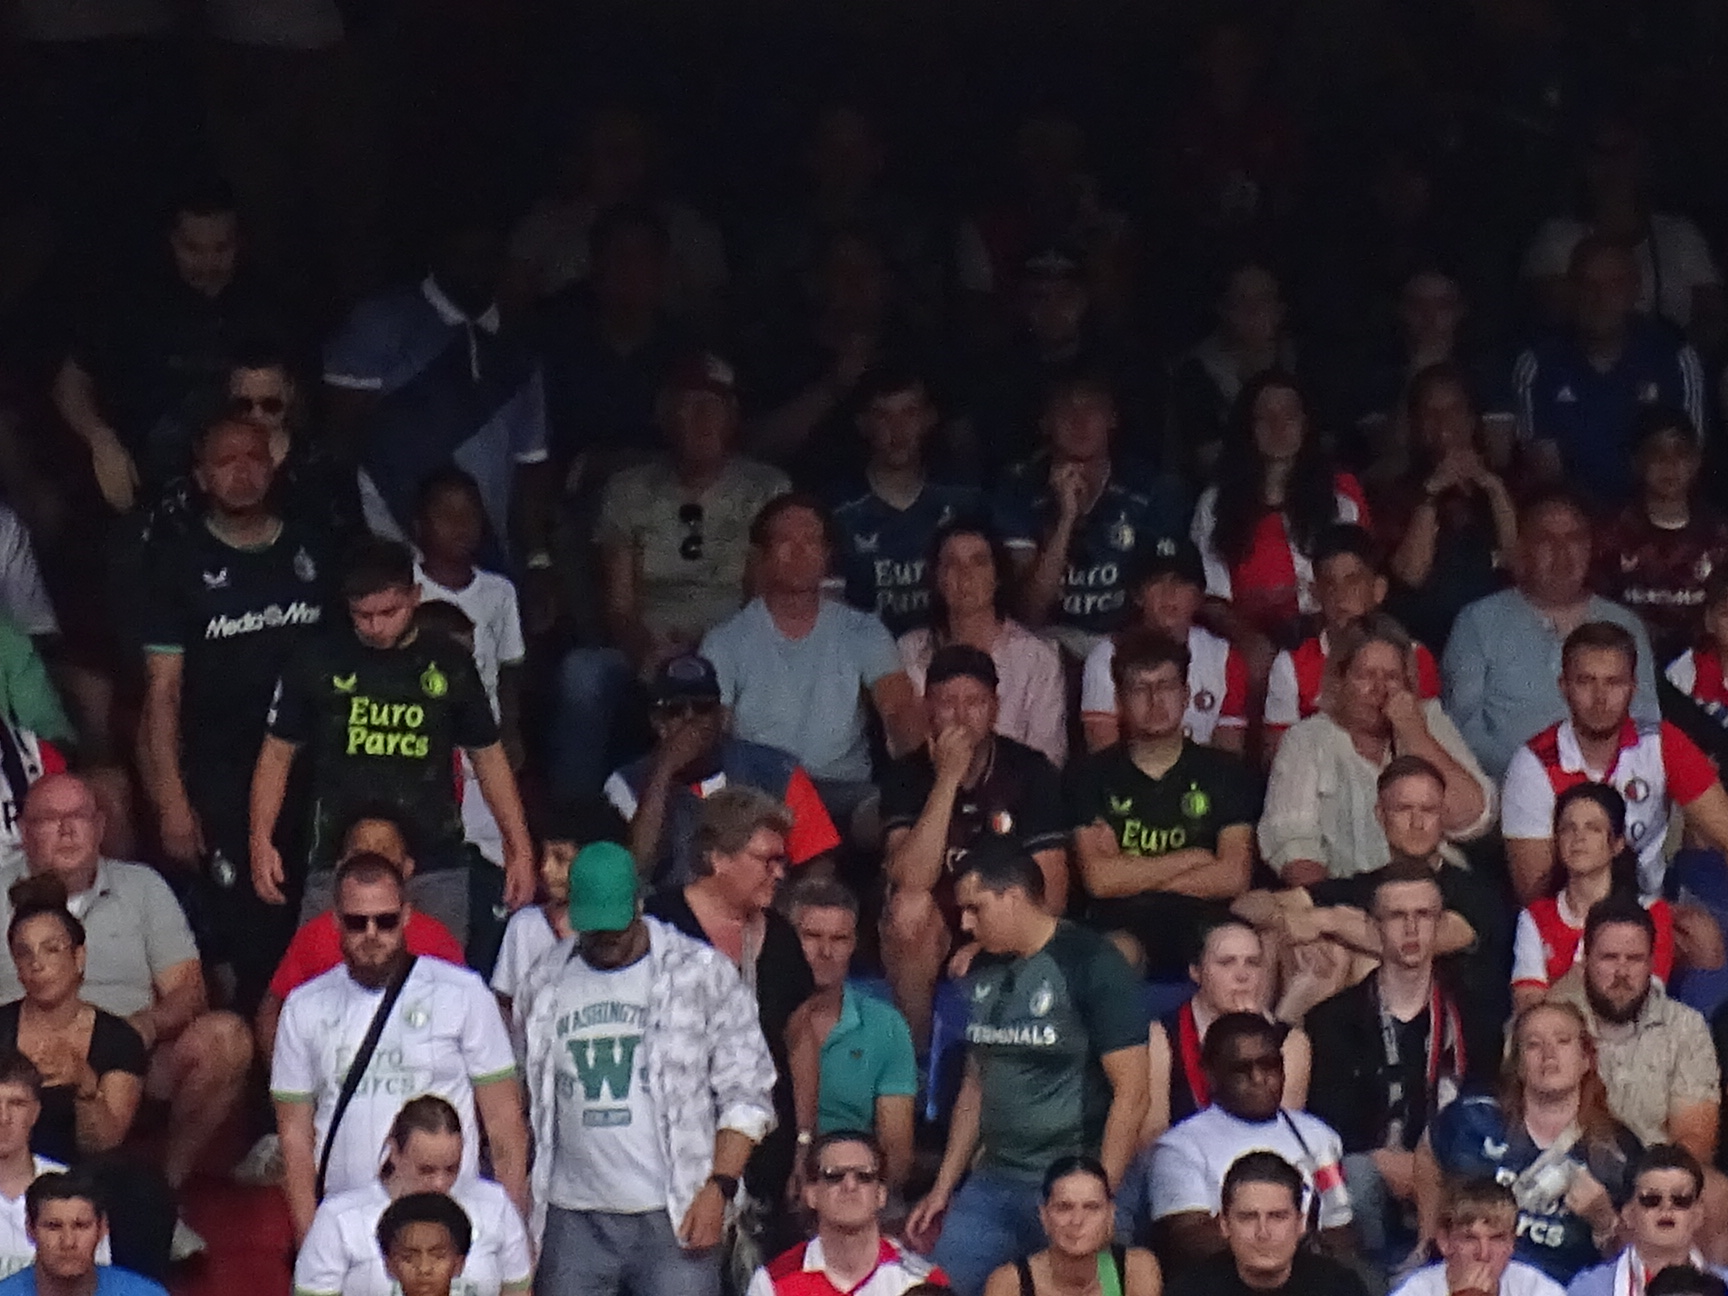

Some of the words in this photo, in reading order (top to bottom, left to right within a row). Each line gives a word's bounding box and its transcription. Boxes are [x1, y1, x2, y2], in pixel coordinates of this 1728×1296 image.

[348, 696, 425, 728] Euro
[346, 727, 430, 758] Parcs
[1121, 820, 1186, 853] Euro
[566, 1035, 641, 1101] W
